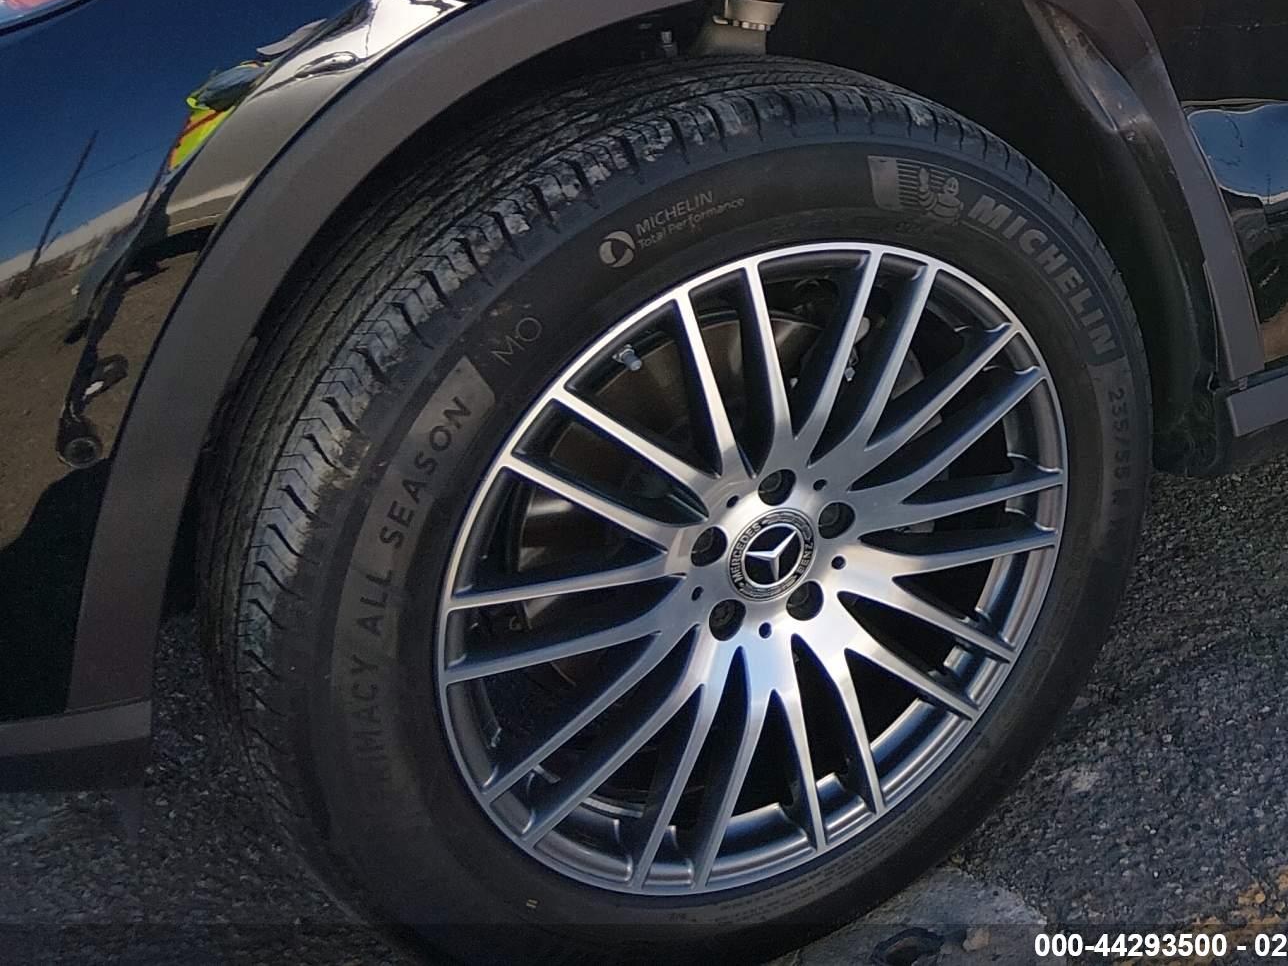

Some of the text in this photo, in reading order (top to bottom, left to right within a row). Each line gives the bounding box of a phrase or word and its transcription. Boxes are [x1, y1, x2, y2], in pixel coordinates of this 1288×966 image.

[635, 189, 714, 237] MICHELIN
[637, 197, 745, 250] Total Performance
[967, 194, 1117, 355] MICHELIN
[489, 316, 544, 367] MO
[355, 569, 393, 637] ALL
[378, 395, 473, 550] SEASON
[730, 522, 814, 583] MERCEDES BENZ
